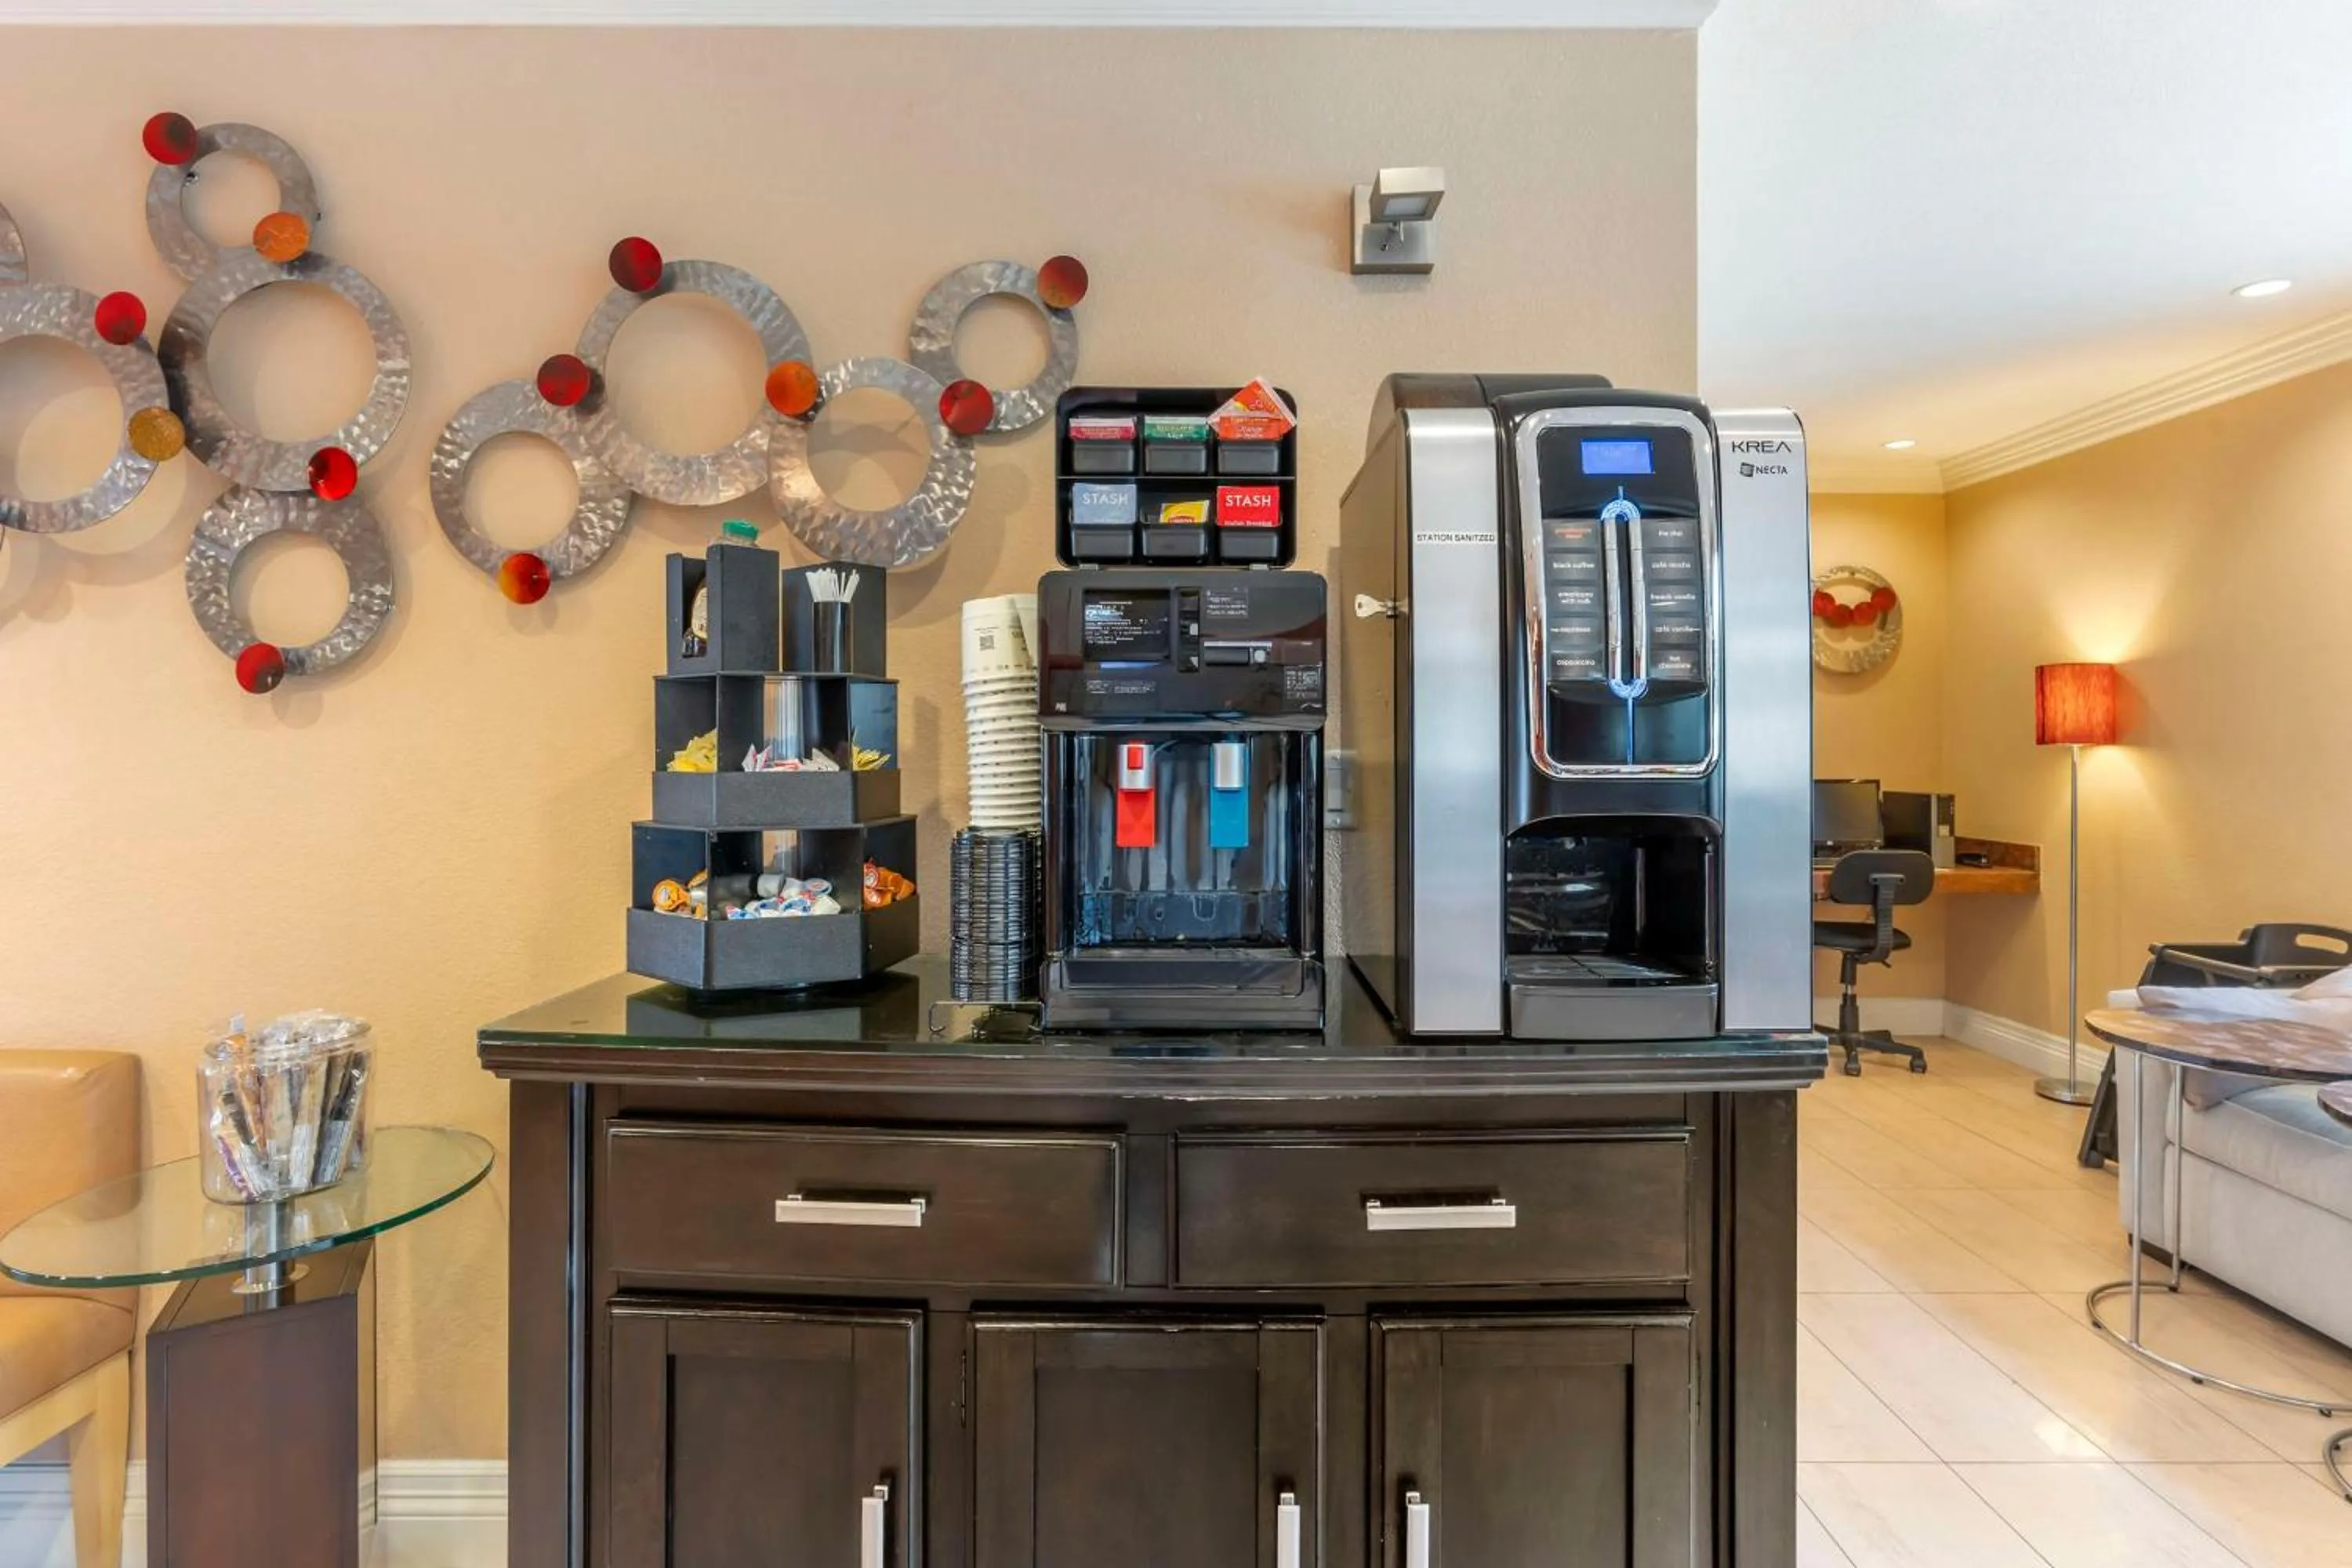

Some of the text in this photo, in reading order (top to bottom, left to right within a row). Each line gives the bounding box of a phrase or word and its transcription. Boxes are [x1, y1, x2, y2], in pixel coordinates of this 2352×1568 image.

[1732, 440, 1792, 453] KREA
[1755, 465, 1788, 475] NECTA
[1082, 492, 1128, 505] STASH
[1225, 495, 1271, 507] STASH
